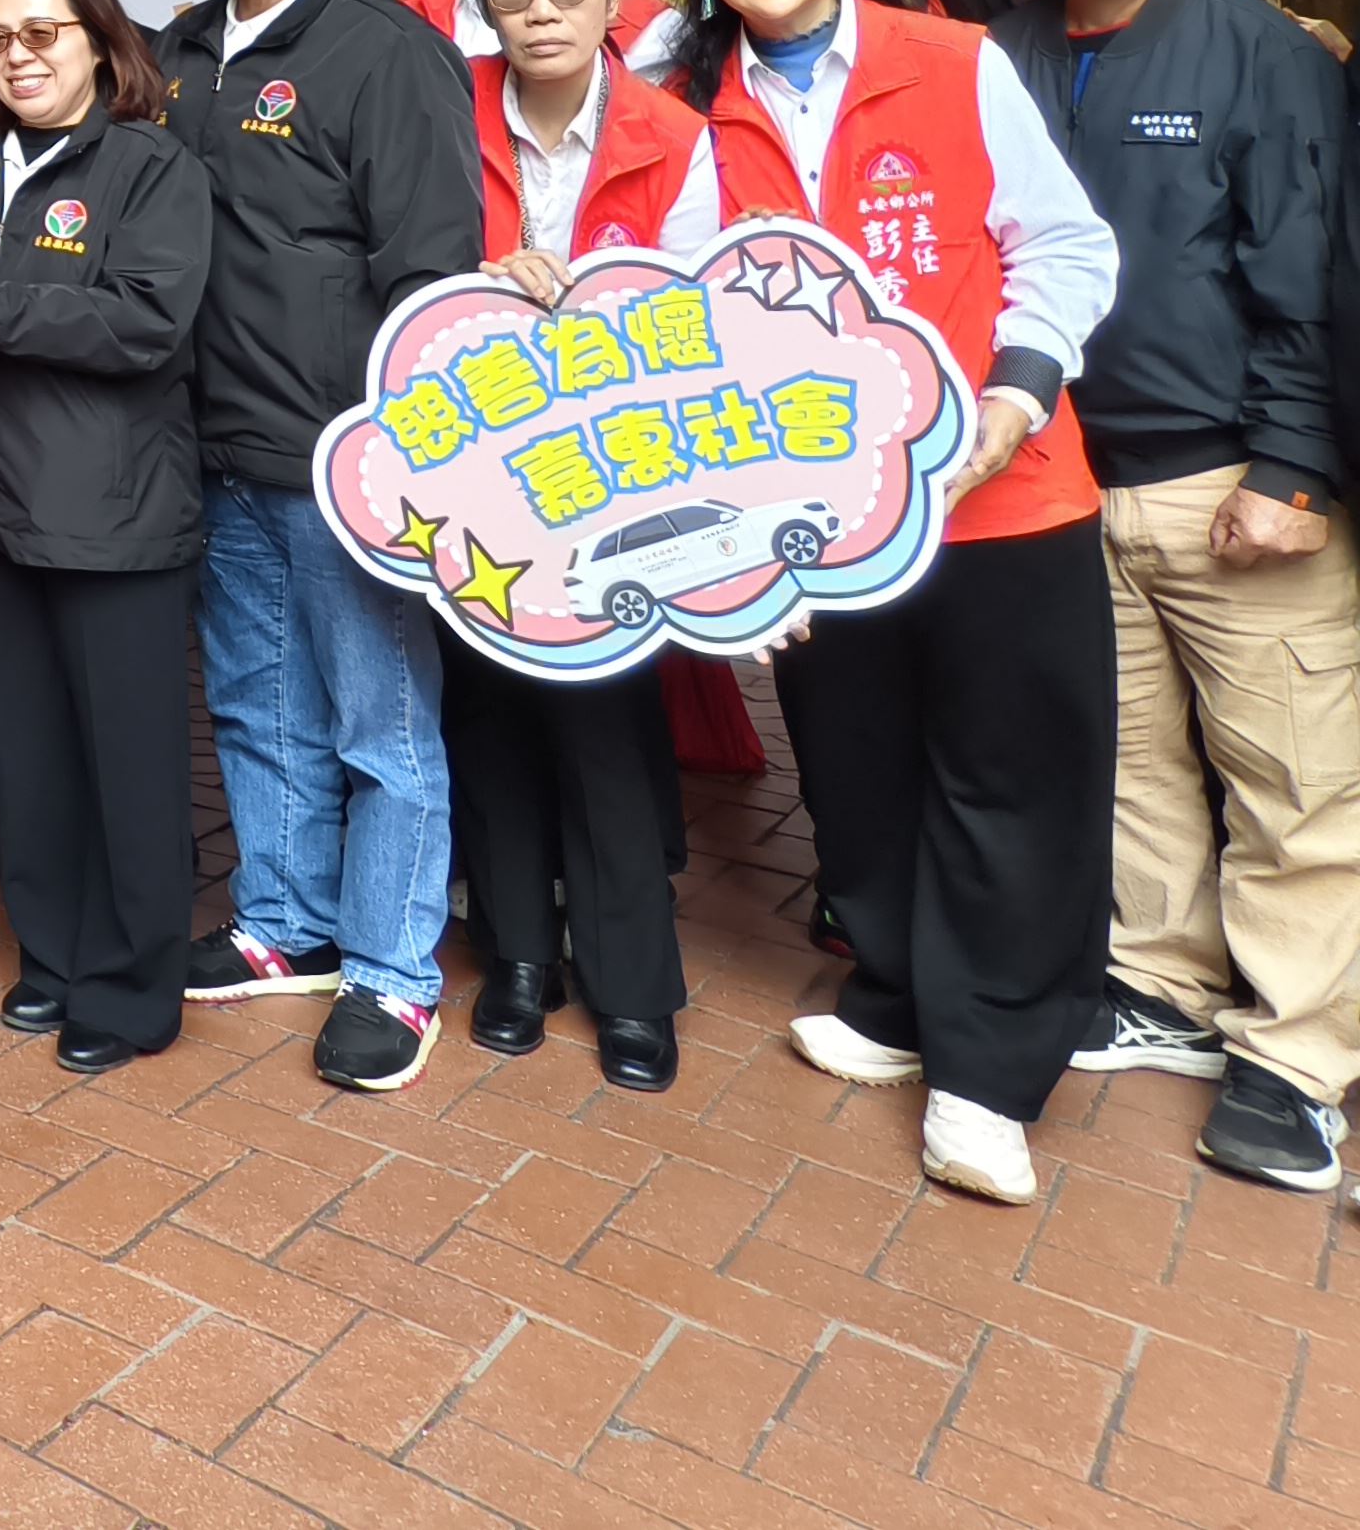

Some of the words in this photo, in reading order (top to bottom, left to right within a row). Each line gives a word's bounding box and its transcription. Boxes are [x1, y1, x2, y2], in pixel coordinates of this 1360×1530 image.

[911, 213, 941, 276] 主任
[377, 278, 723, 470] 慈善為懷
[502, 371, 857, 530] 嘉惠社會
